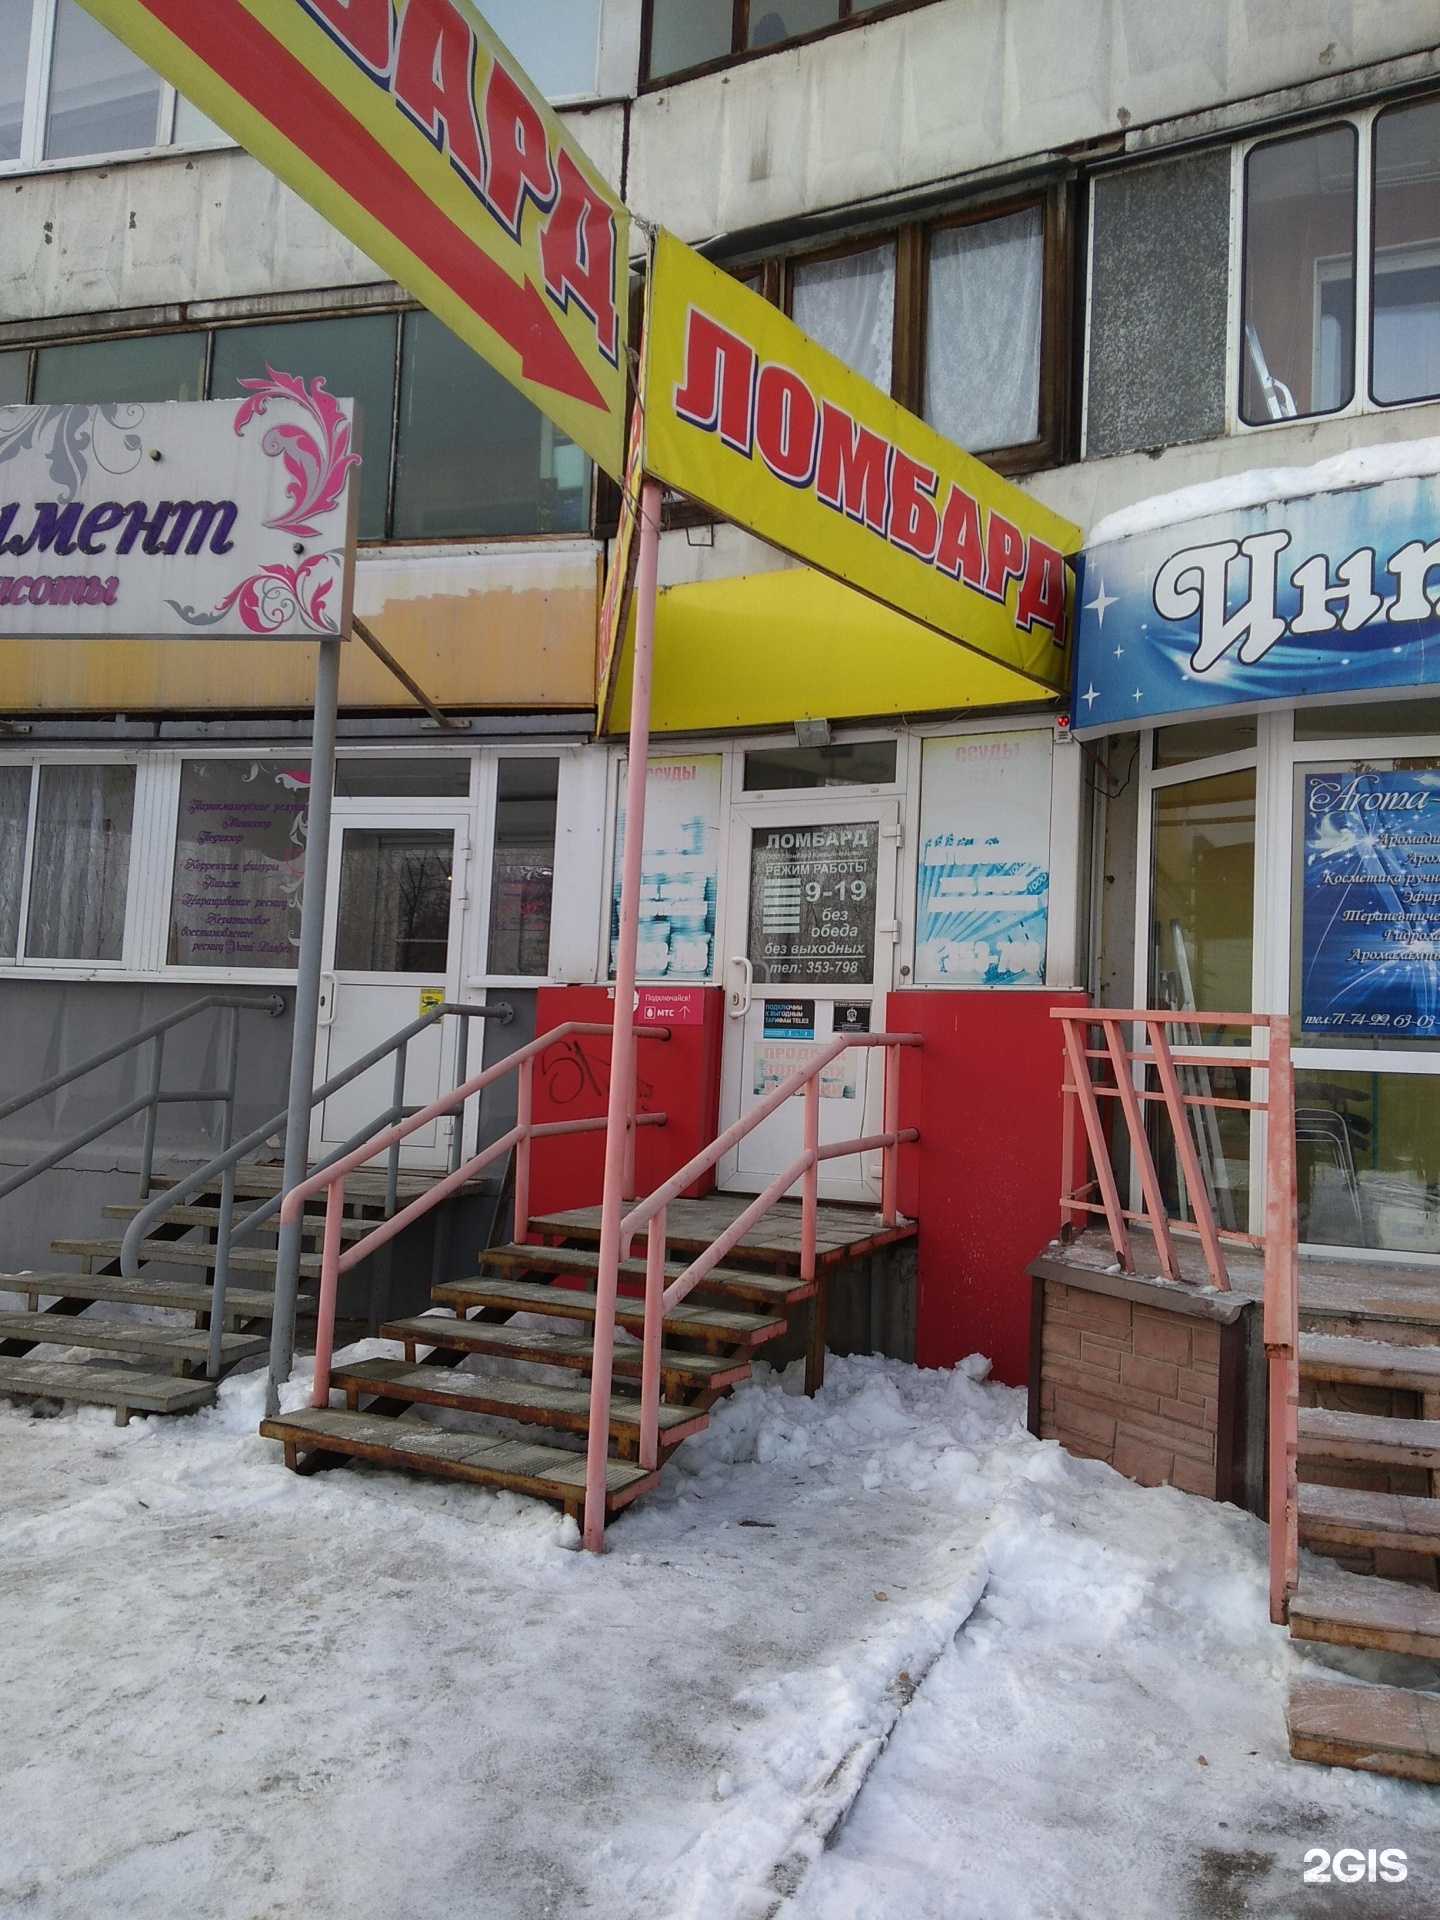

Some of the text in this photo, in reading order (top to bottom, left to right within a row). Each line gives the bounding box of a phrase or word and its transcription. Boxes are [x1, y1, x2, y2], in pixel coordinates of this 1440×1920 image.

[673, 303, 1067, 648] ЛОМБАРД
[767, 830, 869, 849] ЛОМБАРД
[766, 862, 867, 876] РЕЖИМ РАБОТЫ
[805, 880, 867, 902] 9-19
[822, 907, 849, 921] без
[811, 924, 858, 937] обеда
[765, 942, 865, 954] без выходных
[806, 961, 858, 974] 353-798
[657, 1009, 675, 1017] МТС
